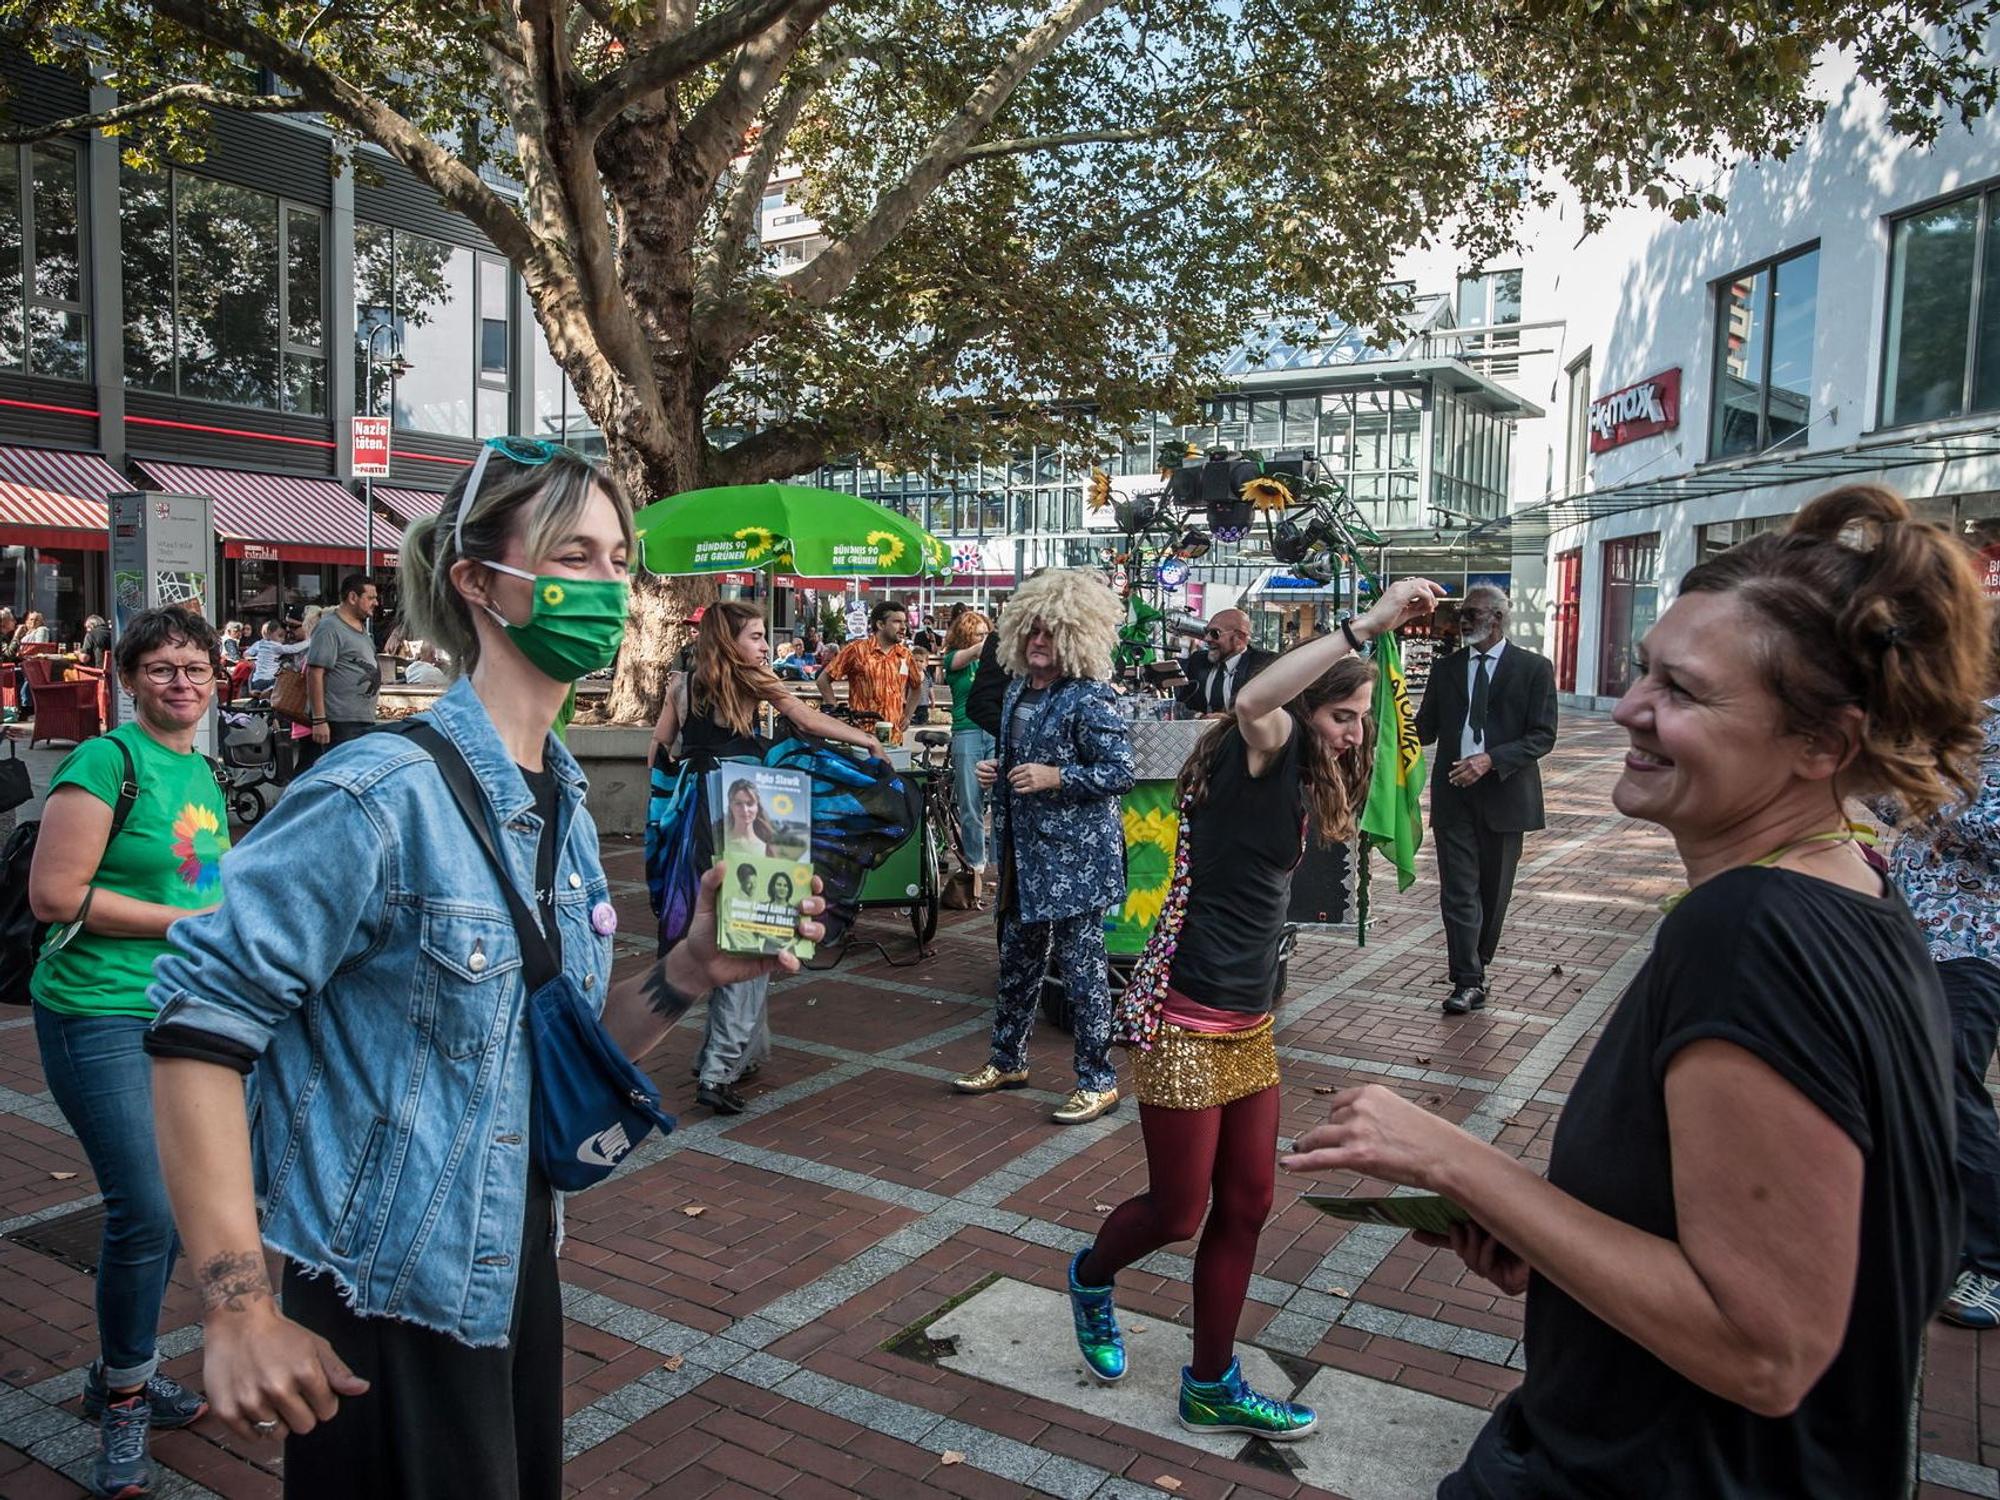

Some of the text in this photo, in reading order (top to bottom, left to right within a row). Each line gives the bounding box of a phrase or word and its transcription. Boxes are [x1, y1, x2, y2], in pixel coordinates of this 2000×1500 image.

[355, 421, 387, 436] Nazis
[355, 436, 386, 450] töten.
[697, 540, 748, 552] BÜNDNIS 90
[833, 543, 879, 555] BÜNDNIS 90
[694, 549, 746, 562] DIE GRÜNEN
[832, 554, 878, 565] DIE GRÜNEN
